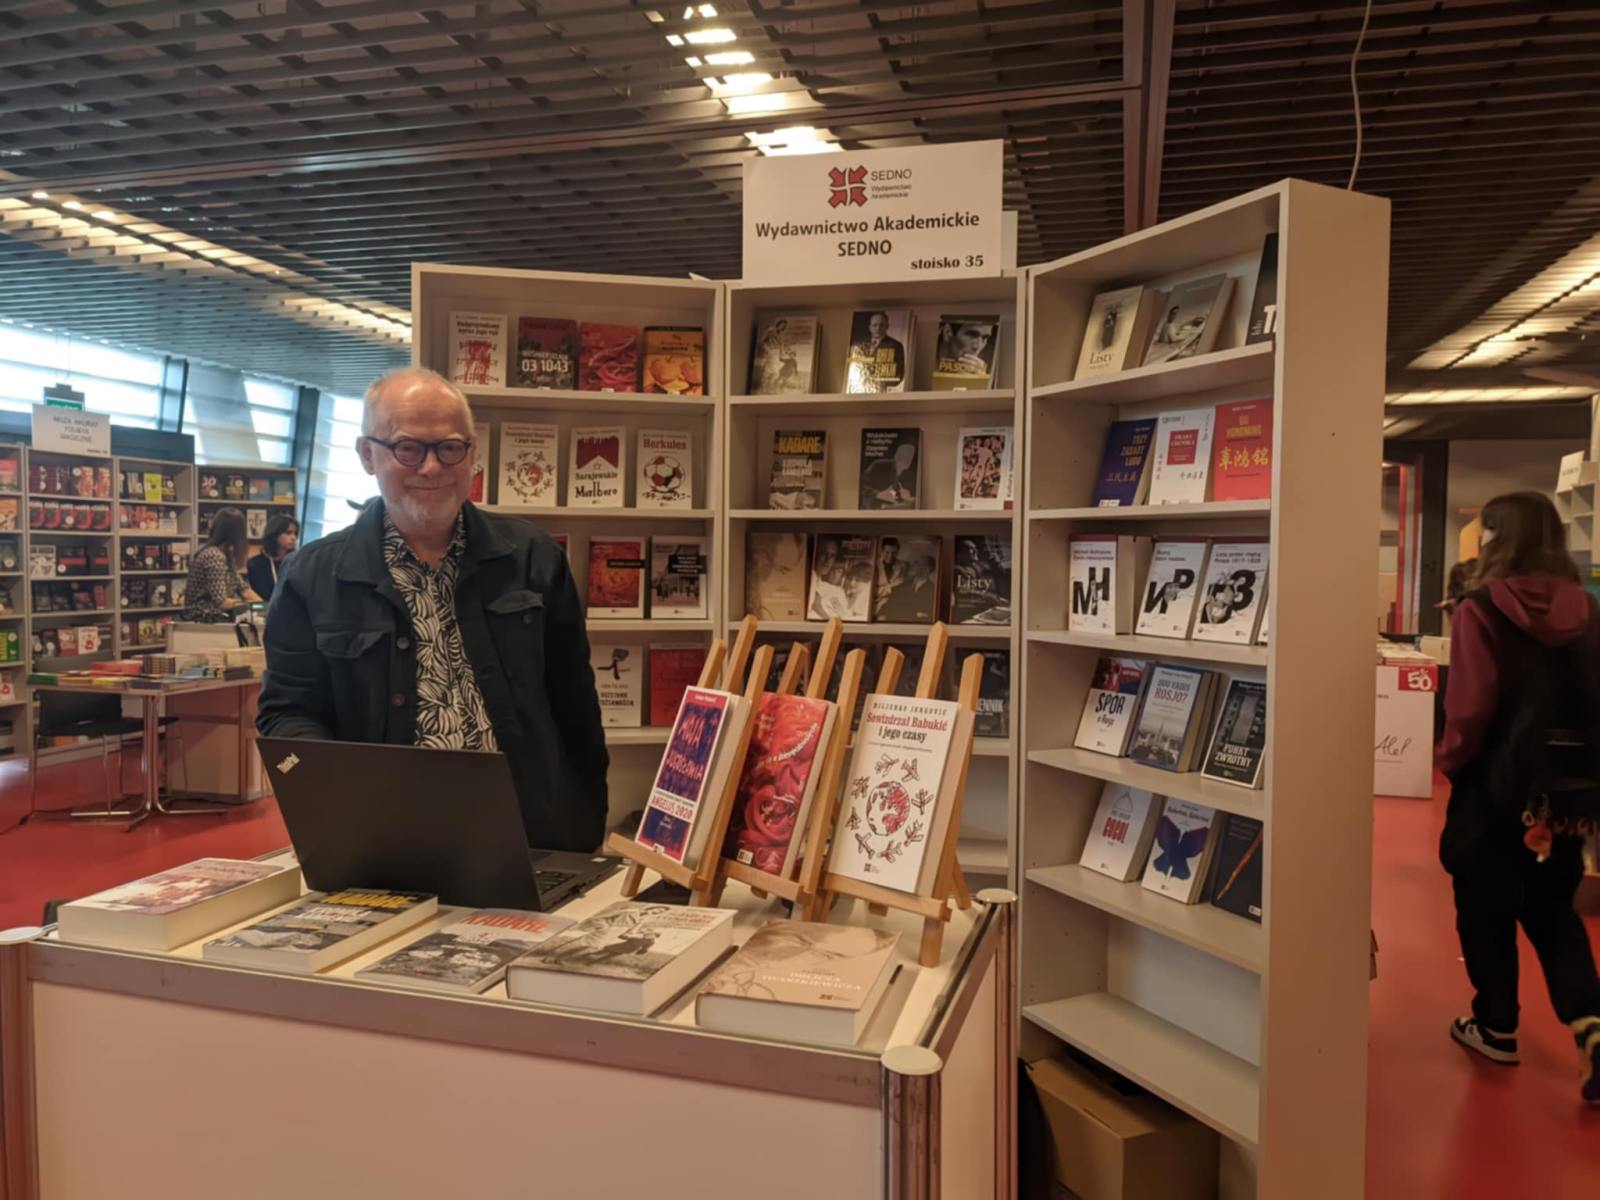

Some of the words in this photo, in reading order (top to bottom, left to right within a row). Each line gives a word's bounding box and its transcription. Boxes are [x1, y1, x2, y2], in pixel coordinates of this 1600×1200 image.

[871, 168, 912, 181] SEDNO
[755, 219, 868, 240] Wydawnictwo
[874, 211, 980, 232] Akademickie
[838, 239, 892, 257] SEDNO
[910, 256, 960, 270] stoisko
[965, 254, 984, 268] 35
[643, 439, 687, 450] Herkules
[956, 574, 992, 591] Listy
[882, 726, 901, 740] jego
[902, 730, 928, 744] czasy
